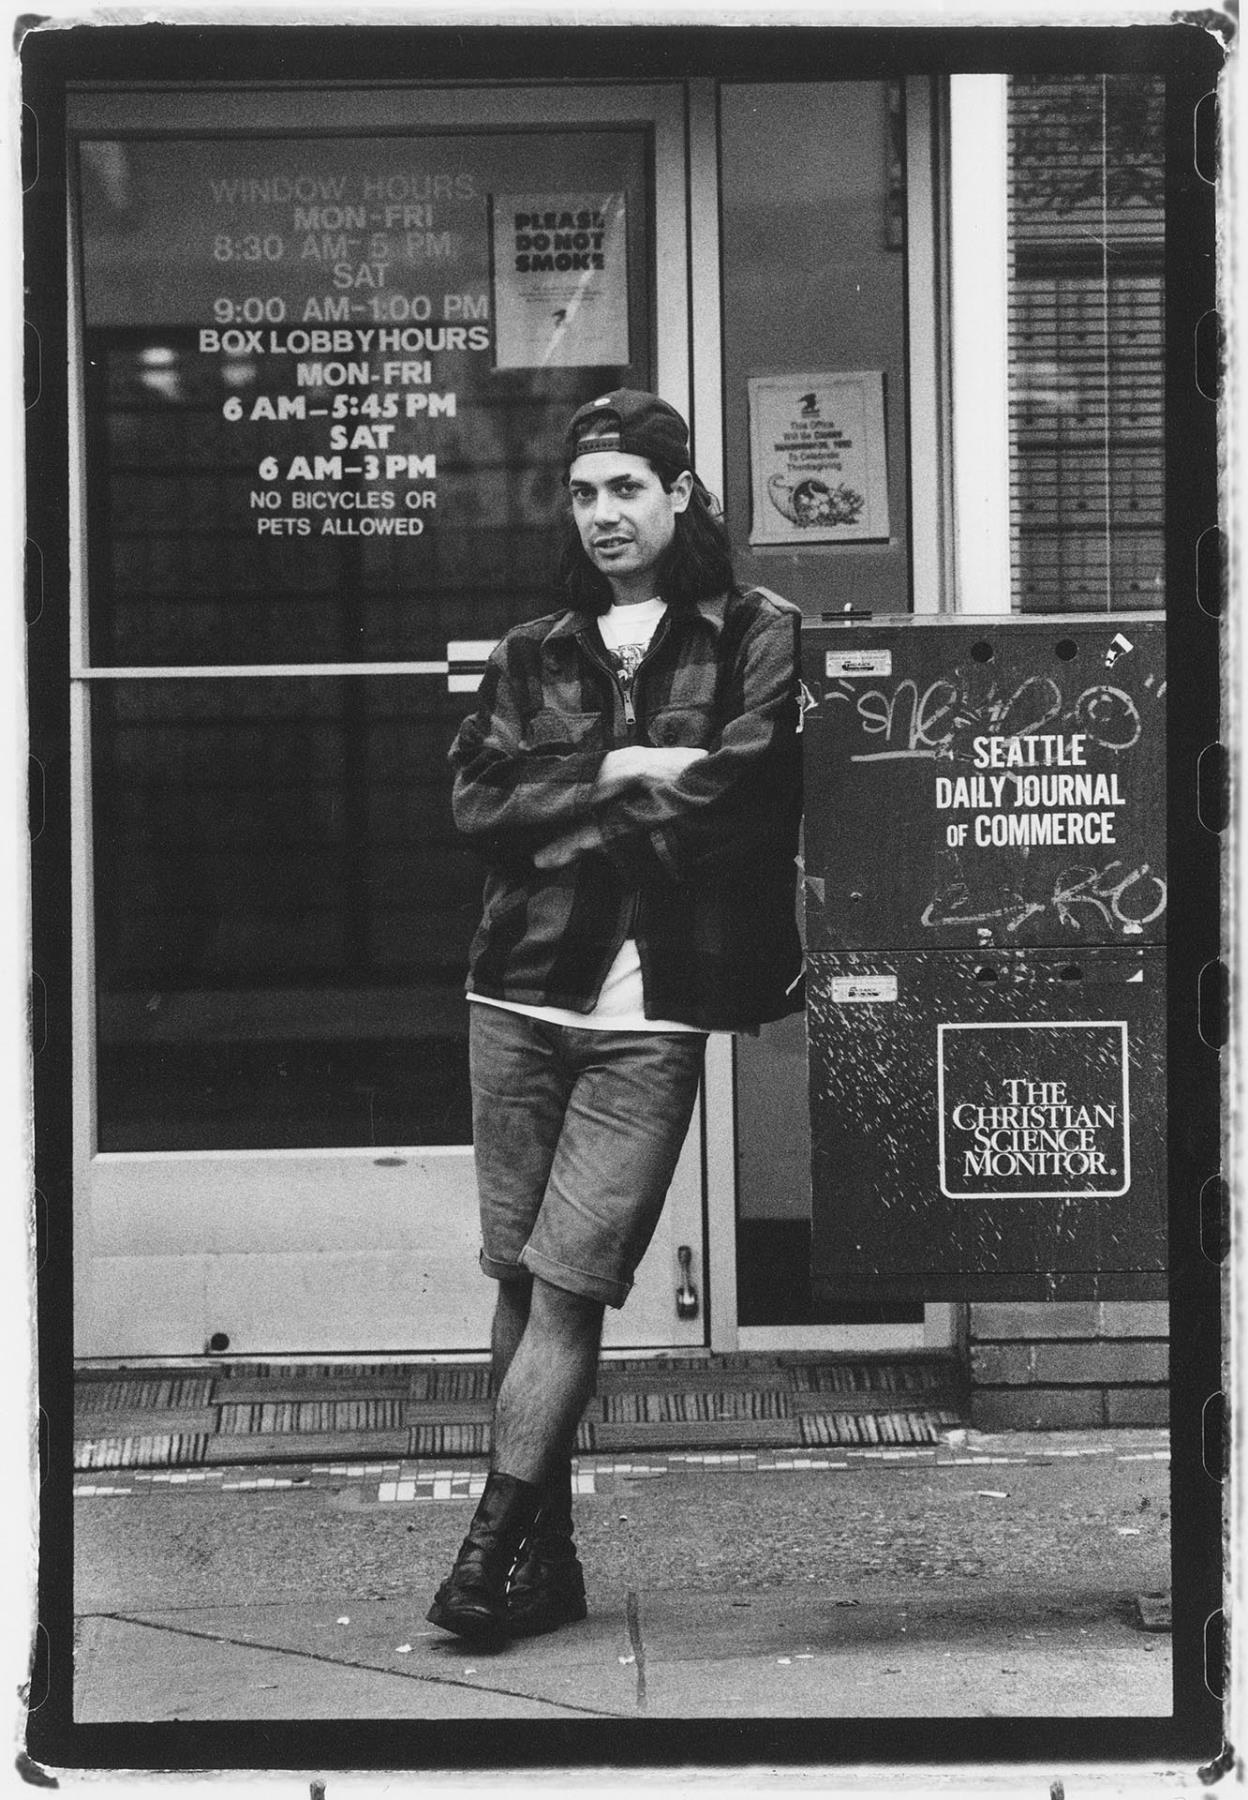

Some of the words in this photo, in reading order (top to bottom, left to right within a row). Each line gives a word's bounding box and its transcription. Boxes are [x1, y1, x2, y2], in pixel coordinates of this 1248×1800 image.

[364, 174, 476, 200] HOURS
[294, 205, 433, 230] MON-FRI
[213, 234, 283, 262] 8:30
[406, 232, 452, 257] PM
[515, 233, 550, 252] DO
[553, 232, 605, 251] NOT
[333, 263, 389, 288] SAT
[514, 253, 605, 272] SMOKE
[214, 297, 285, 324] 9:00
[443, 294, 489, 319] PM
[199, 329, 264, 354] BOX
[271, 328, 376, 354] LOBBY
[379, 326, 490, 352] HOURS
[297, 361, 432, 387] MON-FRI
[222, 396, 243, 421] 6
[405, 392, 457, 418] PM
[329, 424, 395, 451] SAT
[258, 456, 279, 481] 6
[385, 454, 437, 480] PM
[250, 490, 282, 510] NO
[292, 490, 395, 510] BICYCLES
[405, 490, 437, 509] OR
[257, 518, 311, 536] PETS
[321, 517, 424, 536] ALLOWED
[972, 733, 1087, 769] SEATTLE
[935, 775, 1007, 809] DAILY
[1014, 773, 1126, 808] JOURNAL
[946, 824, 969, 848] OF
[974, 811, 1117, 848] COMMERCE
[1002, 1077, 1068, 1106] THE
[952, 1103, 1116, 1131] CHRISTIAN
[974, 1128, 1097, 1153] SCIENCE
